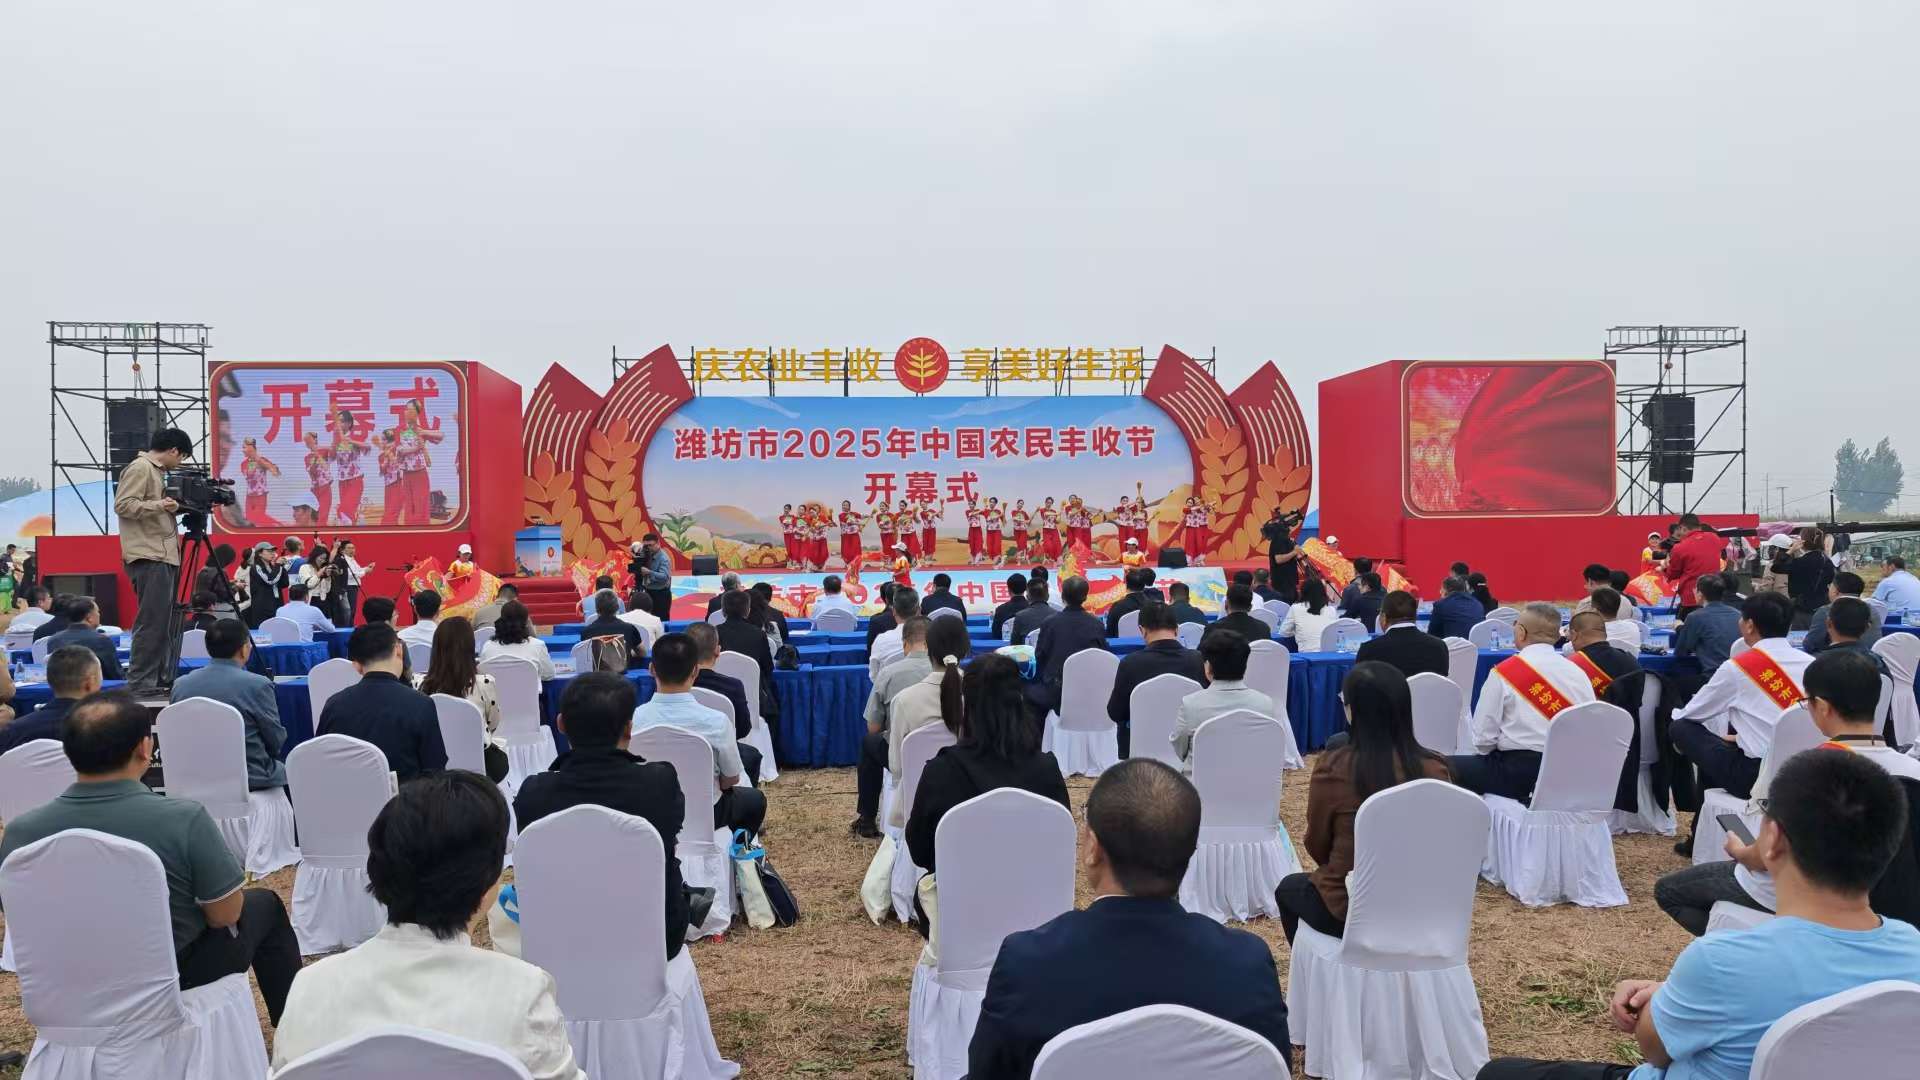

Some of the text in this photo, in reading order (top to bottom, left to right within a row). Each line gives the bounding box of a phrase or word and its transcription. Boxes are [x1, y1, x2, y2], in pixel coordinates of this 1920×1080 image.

[694, 347, 1141, 383] 庆农业丰收 享美好生活
[261, 377, 440, 444] 开幕式
[675, 426, 1155, 459] 潍坊市2025年中国农民丰收节
[864, 471, 979, 504] 开幕式
